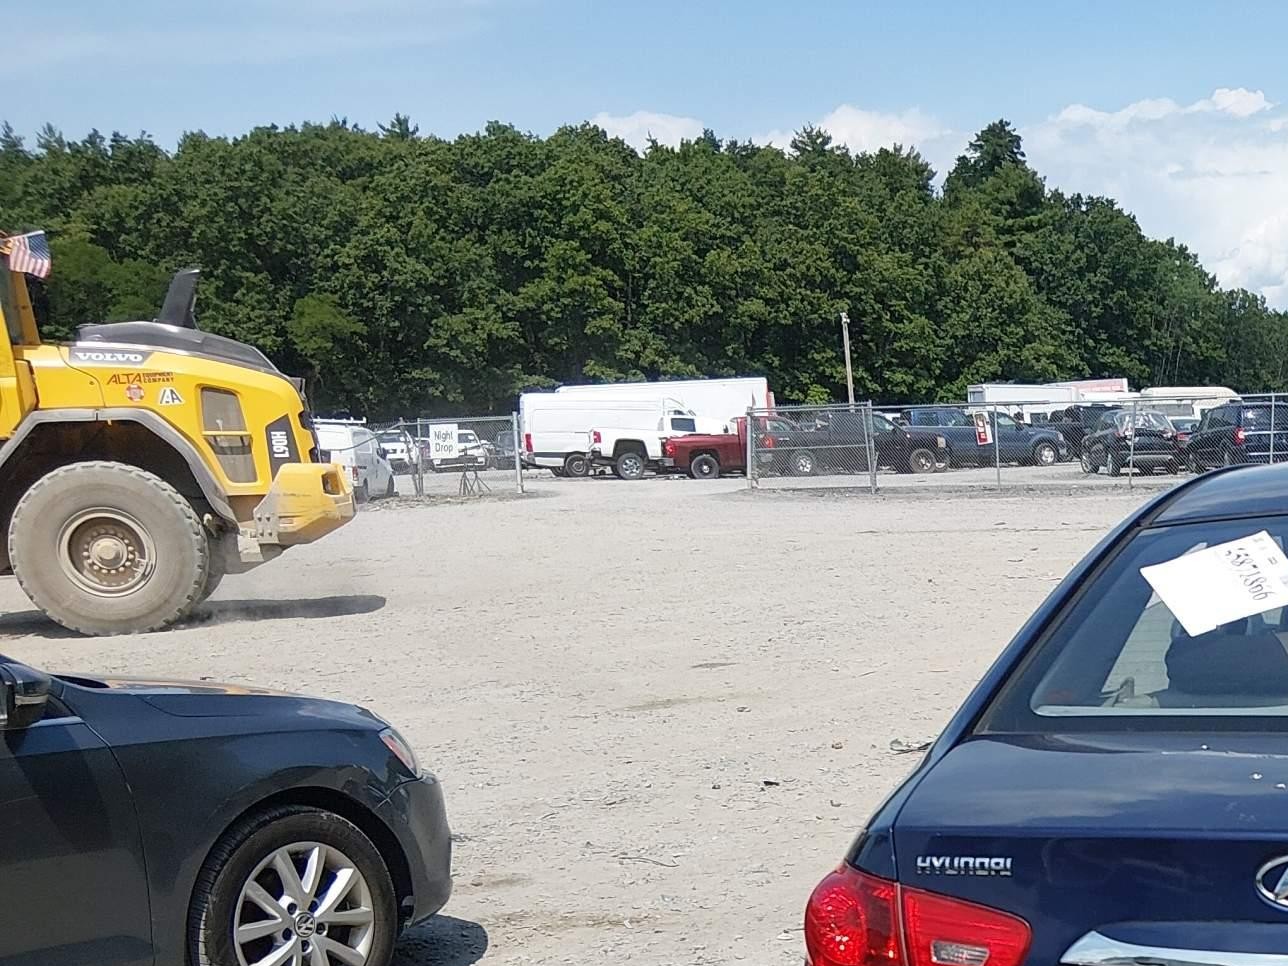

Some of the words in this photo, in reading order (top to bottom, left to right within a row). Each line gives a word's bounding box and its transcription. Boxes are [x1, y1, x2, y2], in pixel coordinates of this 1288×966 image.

[75, 352, 143, 362] VOLVO
[107, 373, 142, 385] ALTA
[434, 430, 454, 443] Night
[435, 443, 453, 455] Drop
[916, 856, 1013, 876] HYUNDAI
